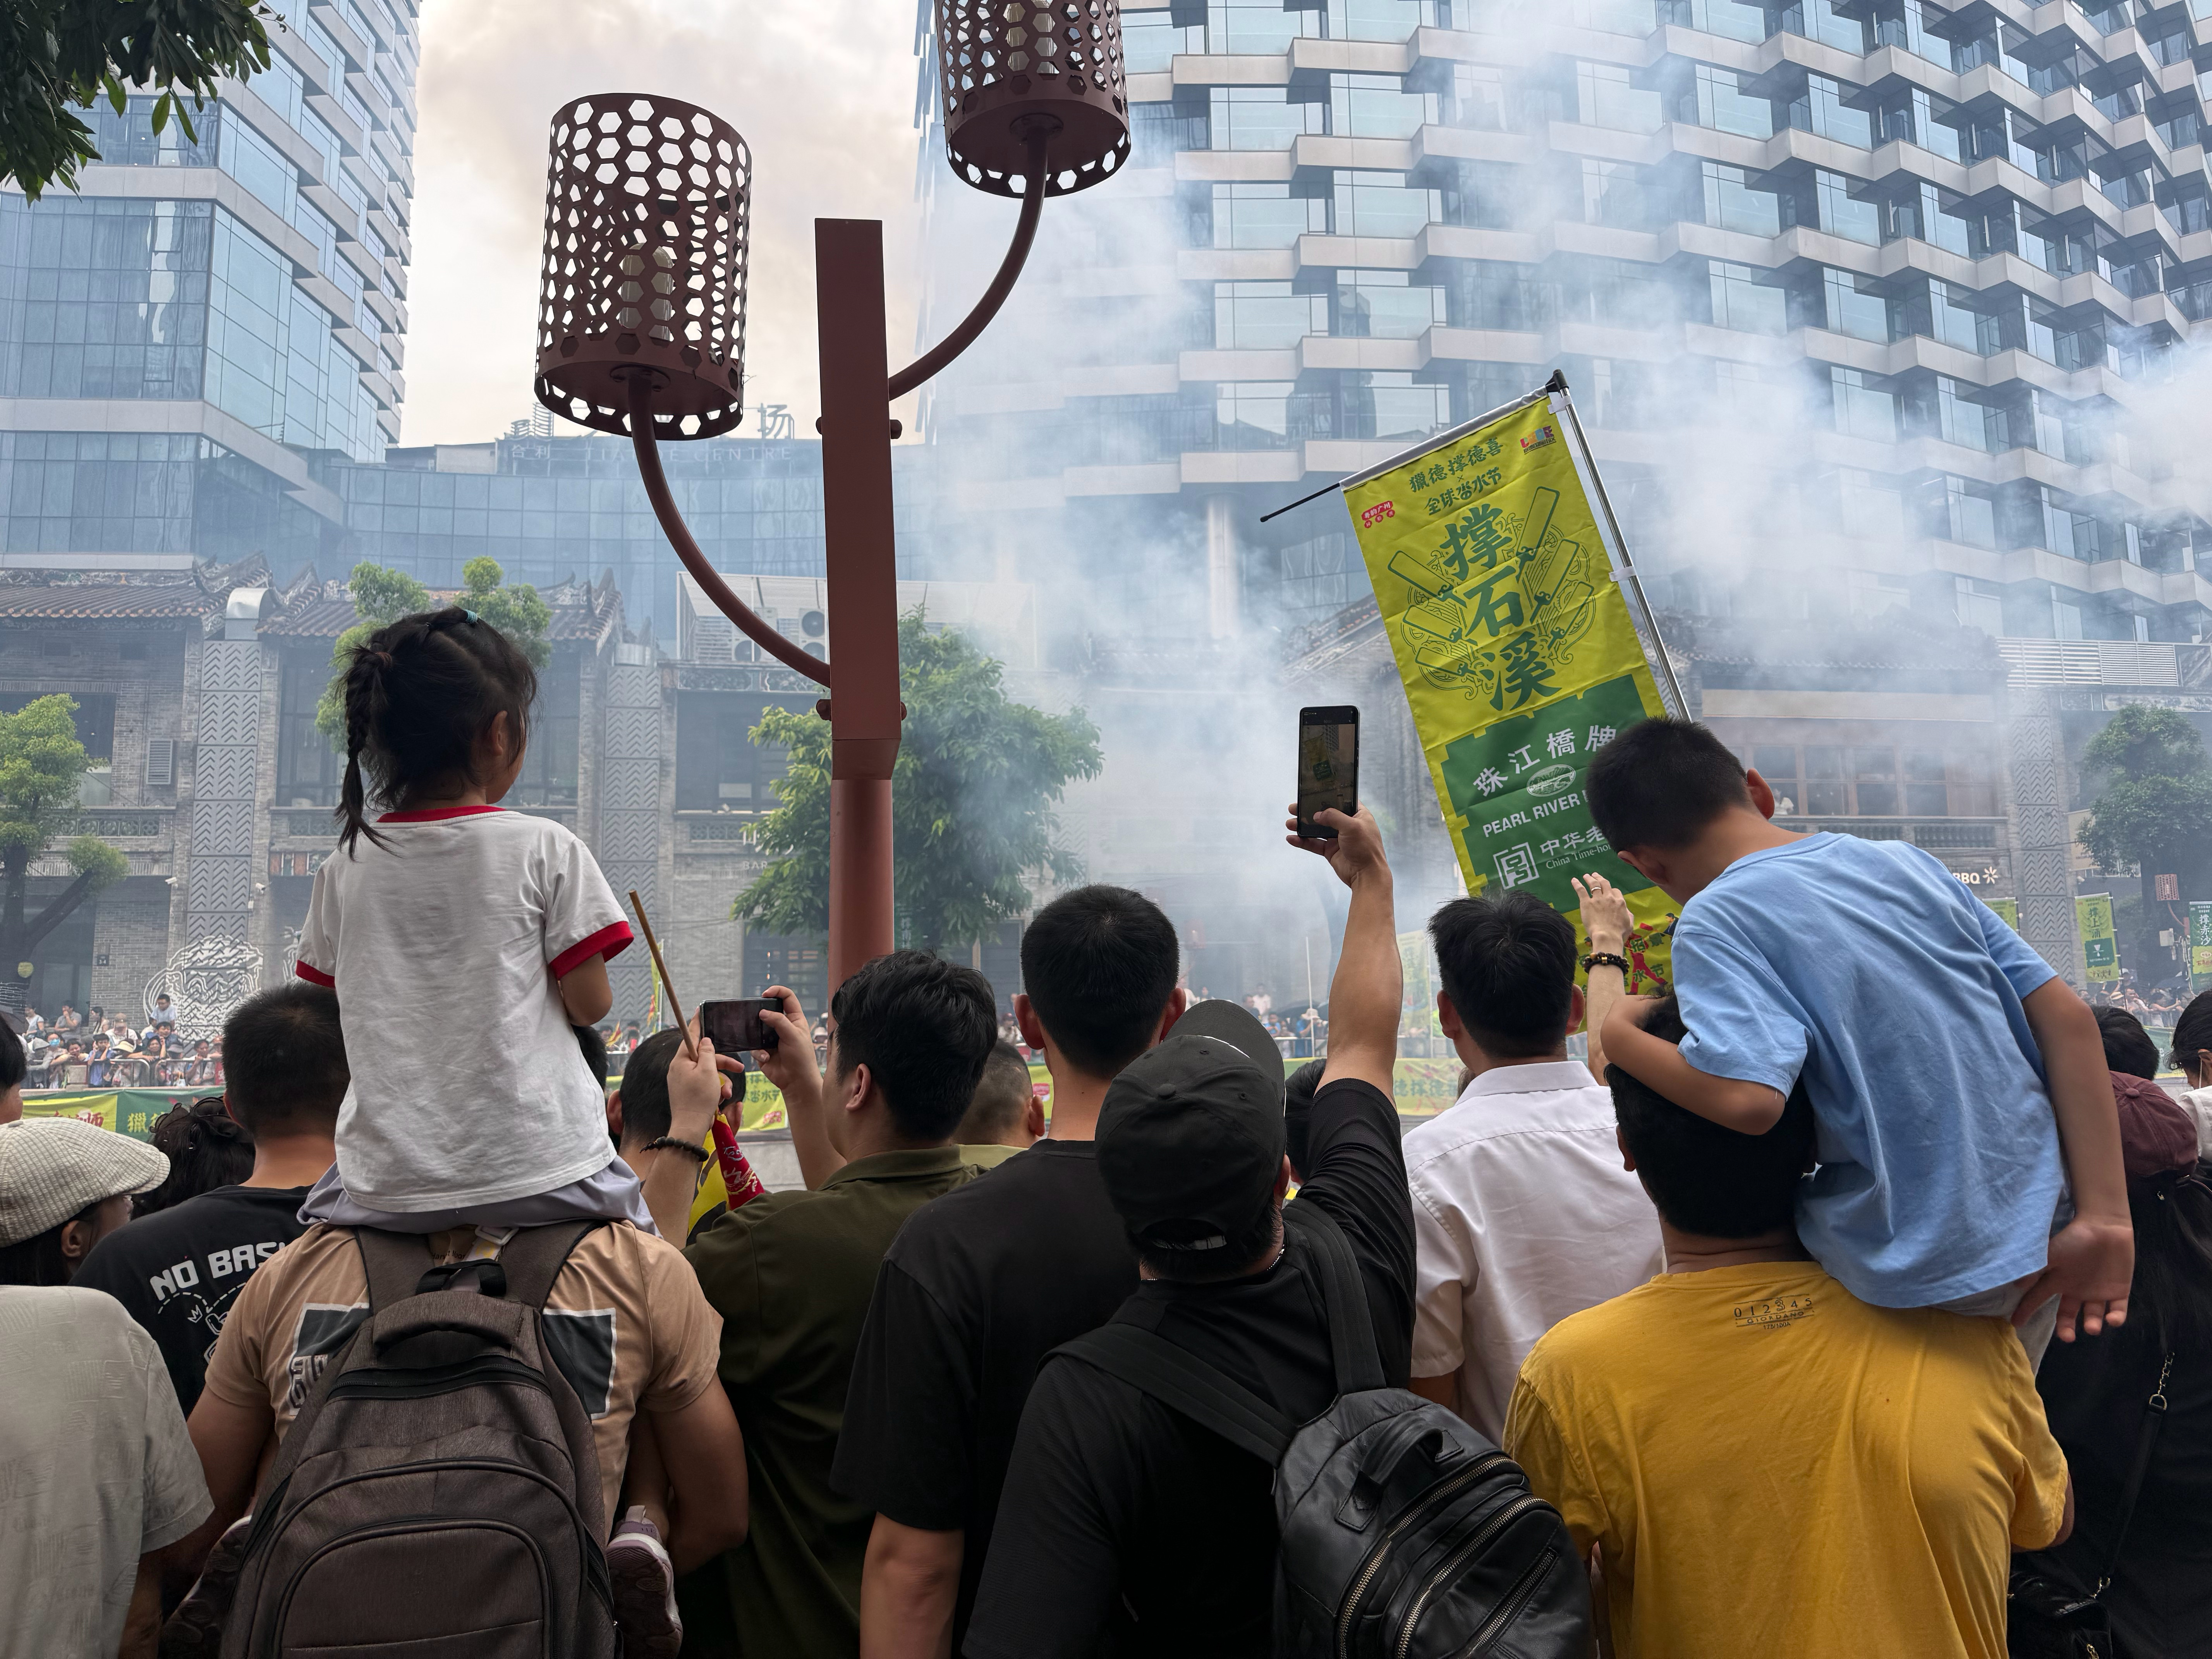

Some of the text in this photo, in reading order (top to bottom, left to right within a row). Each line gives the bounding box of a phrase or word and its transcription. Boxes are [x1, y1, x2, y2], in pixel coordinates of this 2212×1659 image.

[1482, 811, 1531, 838] PEARL
[1532, 793, 1580, 819] RIVER
[1546, 855, 1570, 869] China
[149, 1241, 285, 1301] NO BAS
[1734, 1307, 1741, 1317] 0
[1750, 1306, 1755, 1316] 1
[1762, 1304, 1771, 1314] 2
[1775, 1299, 1785, 1312] 3
[1805, 1298, 1812, 1306] 5
[1747, 1311, 1805, 1324] GIORDANO
